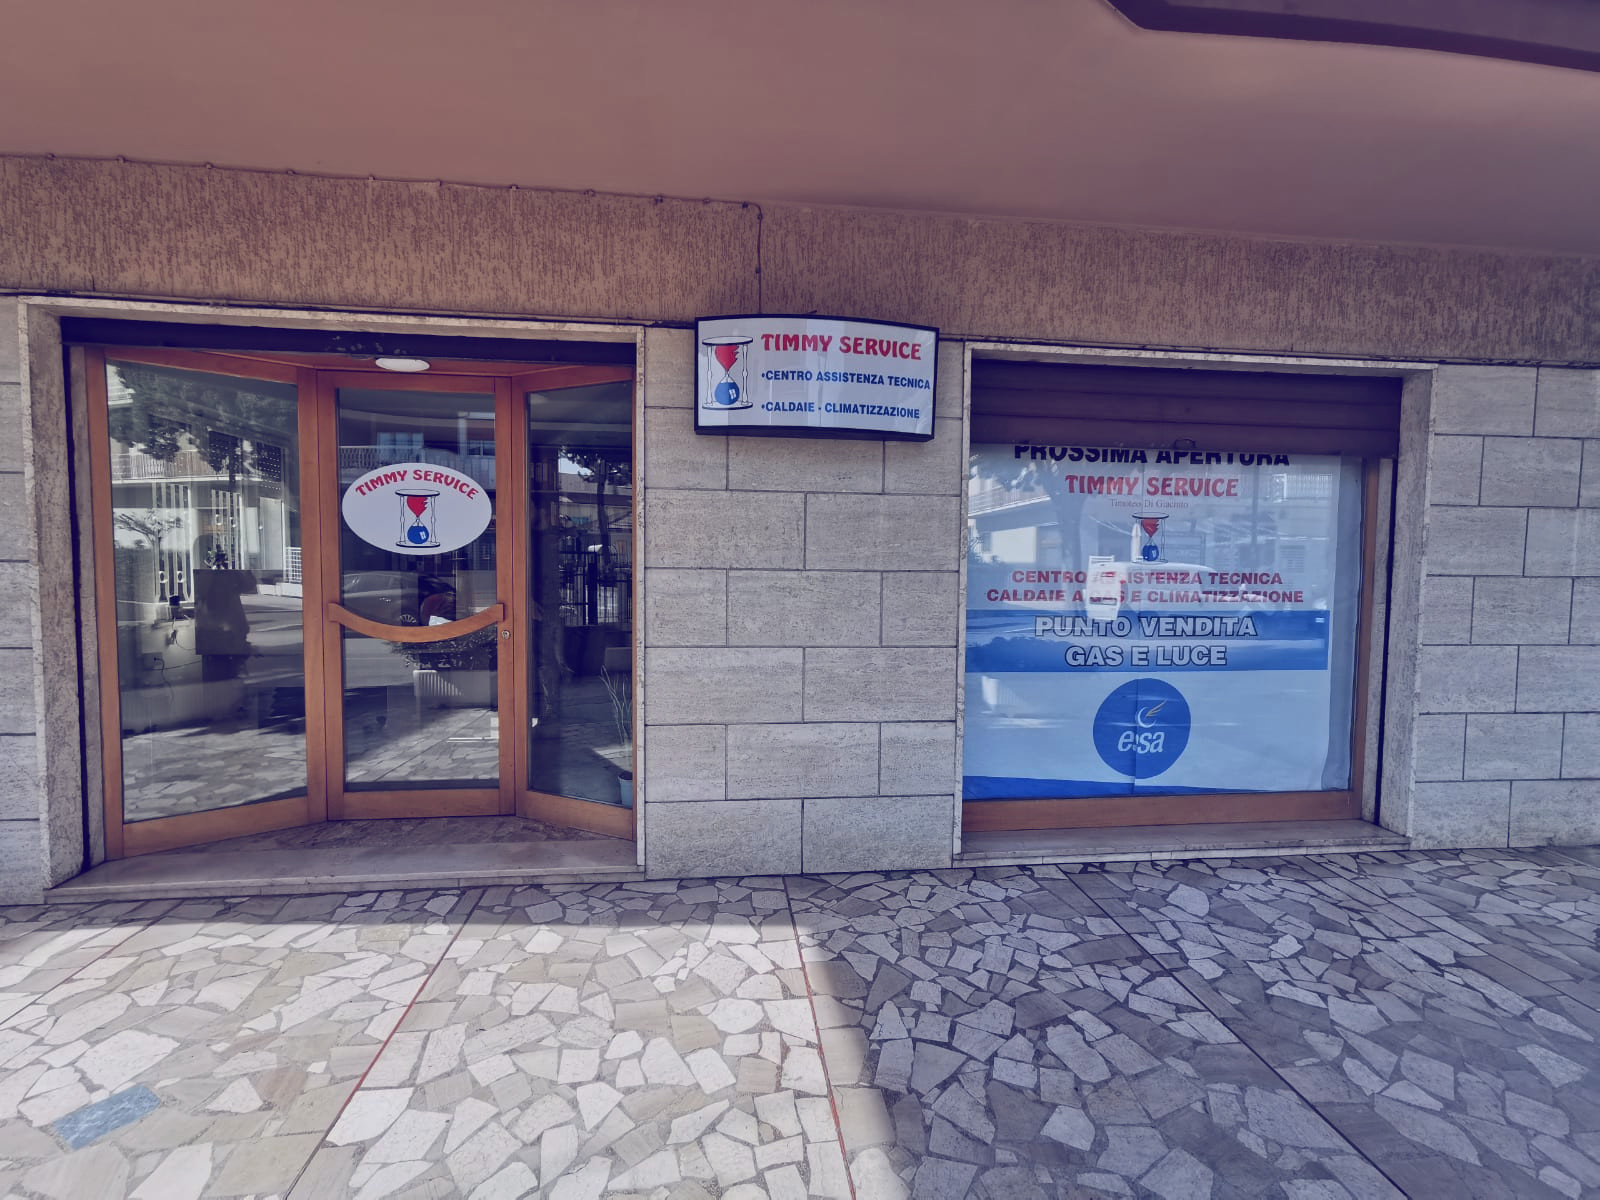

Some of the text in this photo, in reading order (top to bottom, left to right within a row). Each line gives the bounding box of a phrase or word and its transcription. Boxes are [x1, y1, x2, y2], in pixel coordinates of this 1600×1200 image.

[761, 334, 921, 360] TIMMY SERVICE
[816, 371, 884, 385] ASSISTENZA
[887, 376, 930, 390] TECNICA
[825, 403, 920, 419] CLIMATIZZAZIONE
[356, 469, 479, 500] TIMMY SERVICE
[1065, 475, 1239, 497] TIMMY SERVICE
[1012, 570, 1087, 584] CENTRO
[1208, 572, 1283, 585] TECNICA
[986, 589, 1066, 602] CALDAIE
[1072, 589, 1084, 602] A
[1131, 590, 1141, 602] E
[1147, 589, 1303, 603] CLIMATIZZAZIONE
[1034, 615, 1258, 638] PUNTO VENDITA
[1065, 646, 1227, 667] GAS E LUCE
